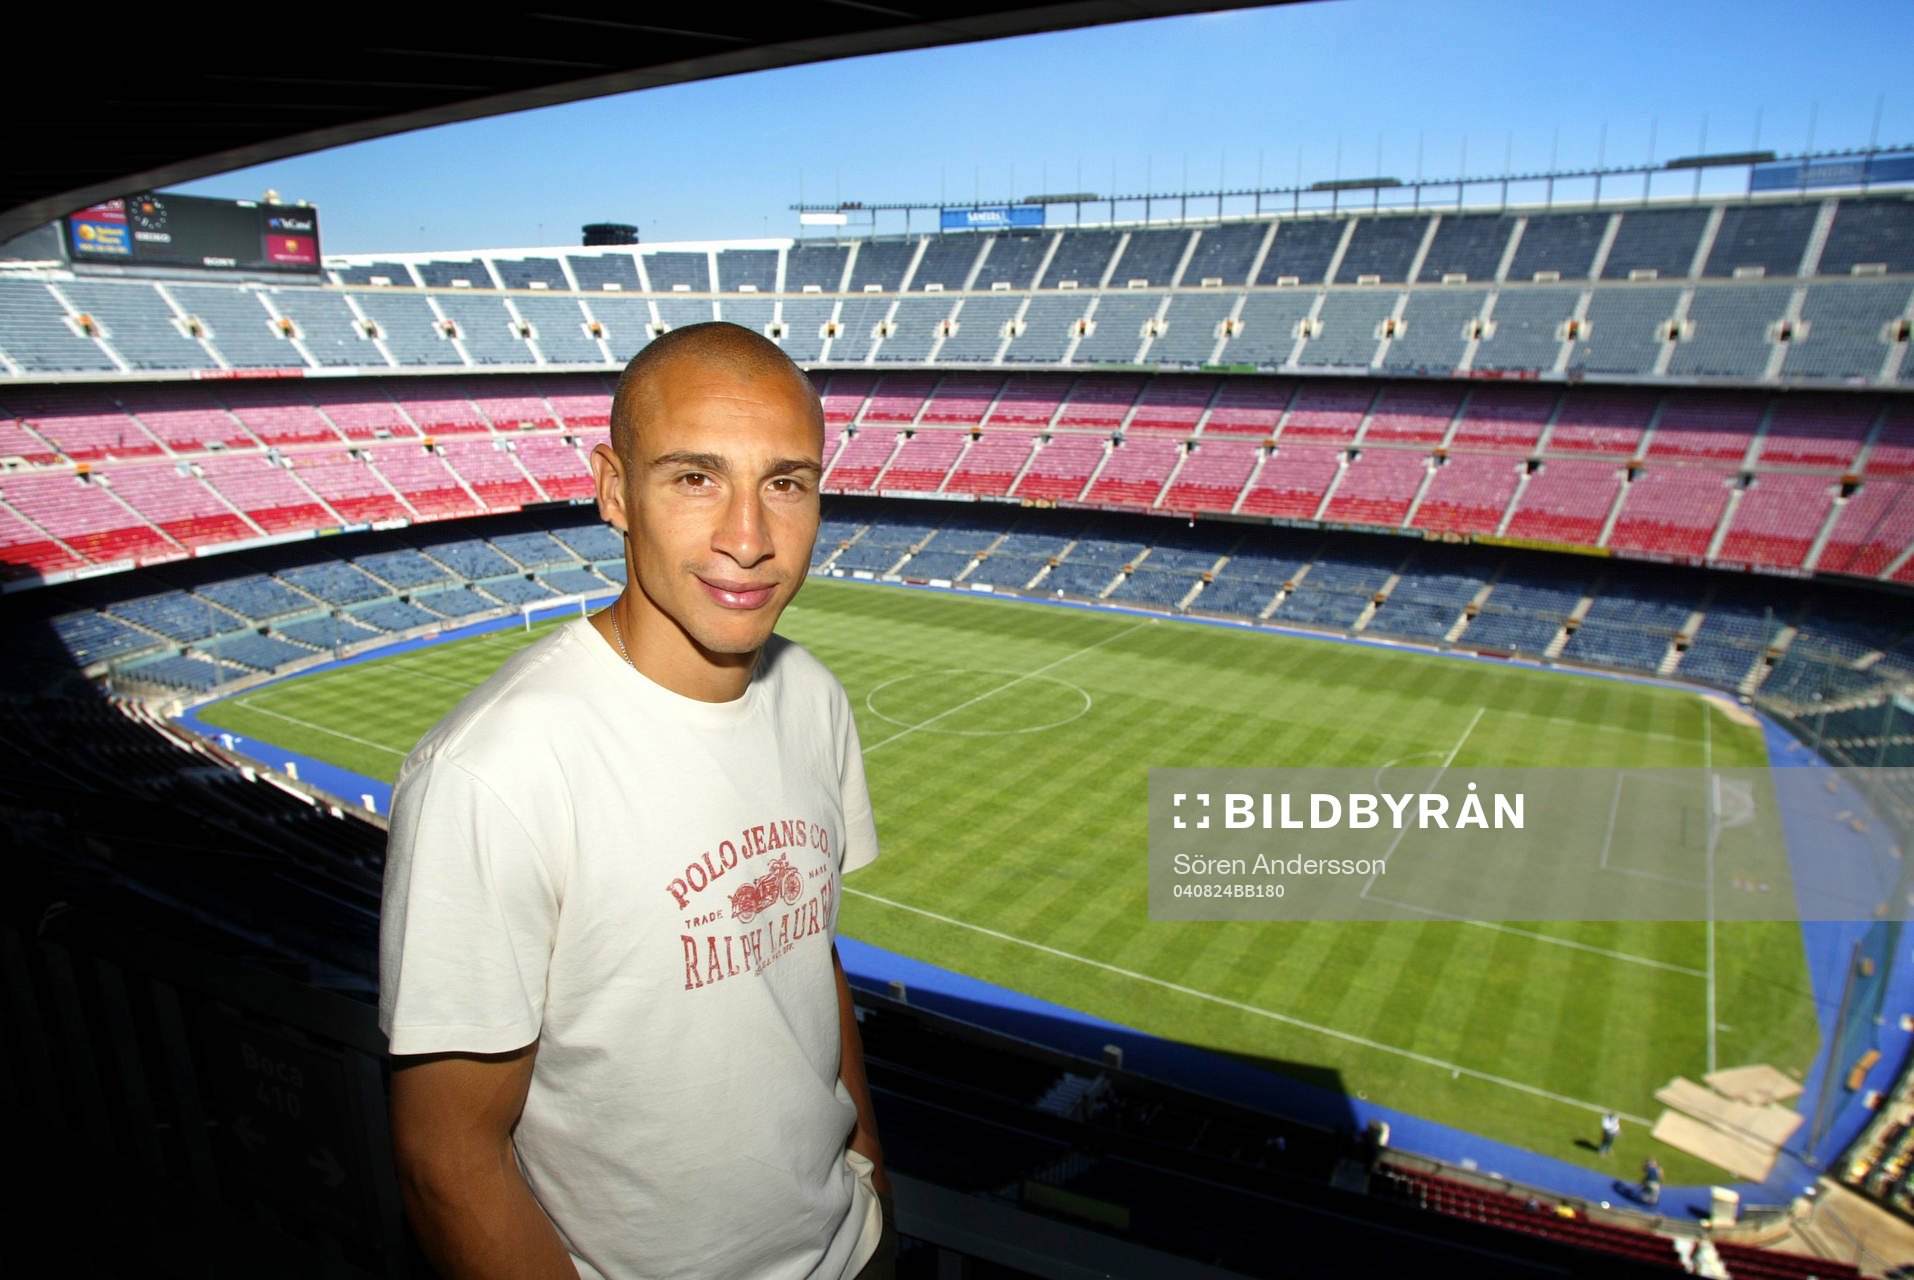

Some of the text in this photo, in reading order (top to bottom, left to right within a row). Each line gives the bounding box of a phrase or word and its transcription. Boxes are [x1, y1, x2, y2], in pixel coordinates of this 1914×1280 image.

[666, 840, 738, 911] POLO
[741, 820, 808, 860] JEANS
[685, 910, 723, 929] TRADE
[680, 928, 763, 991] RALPH
